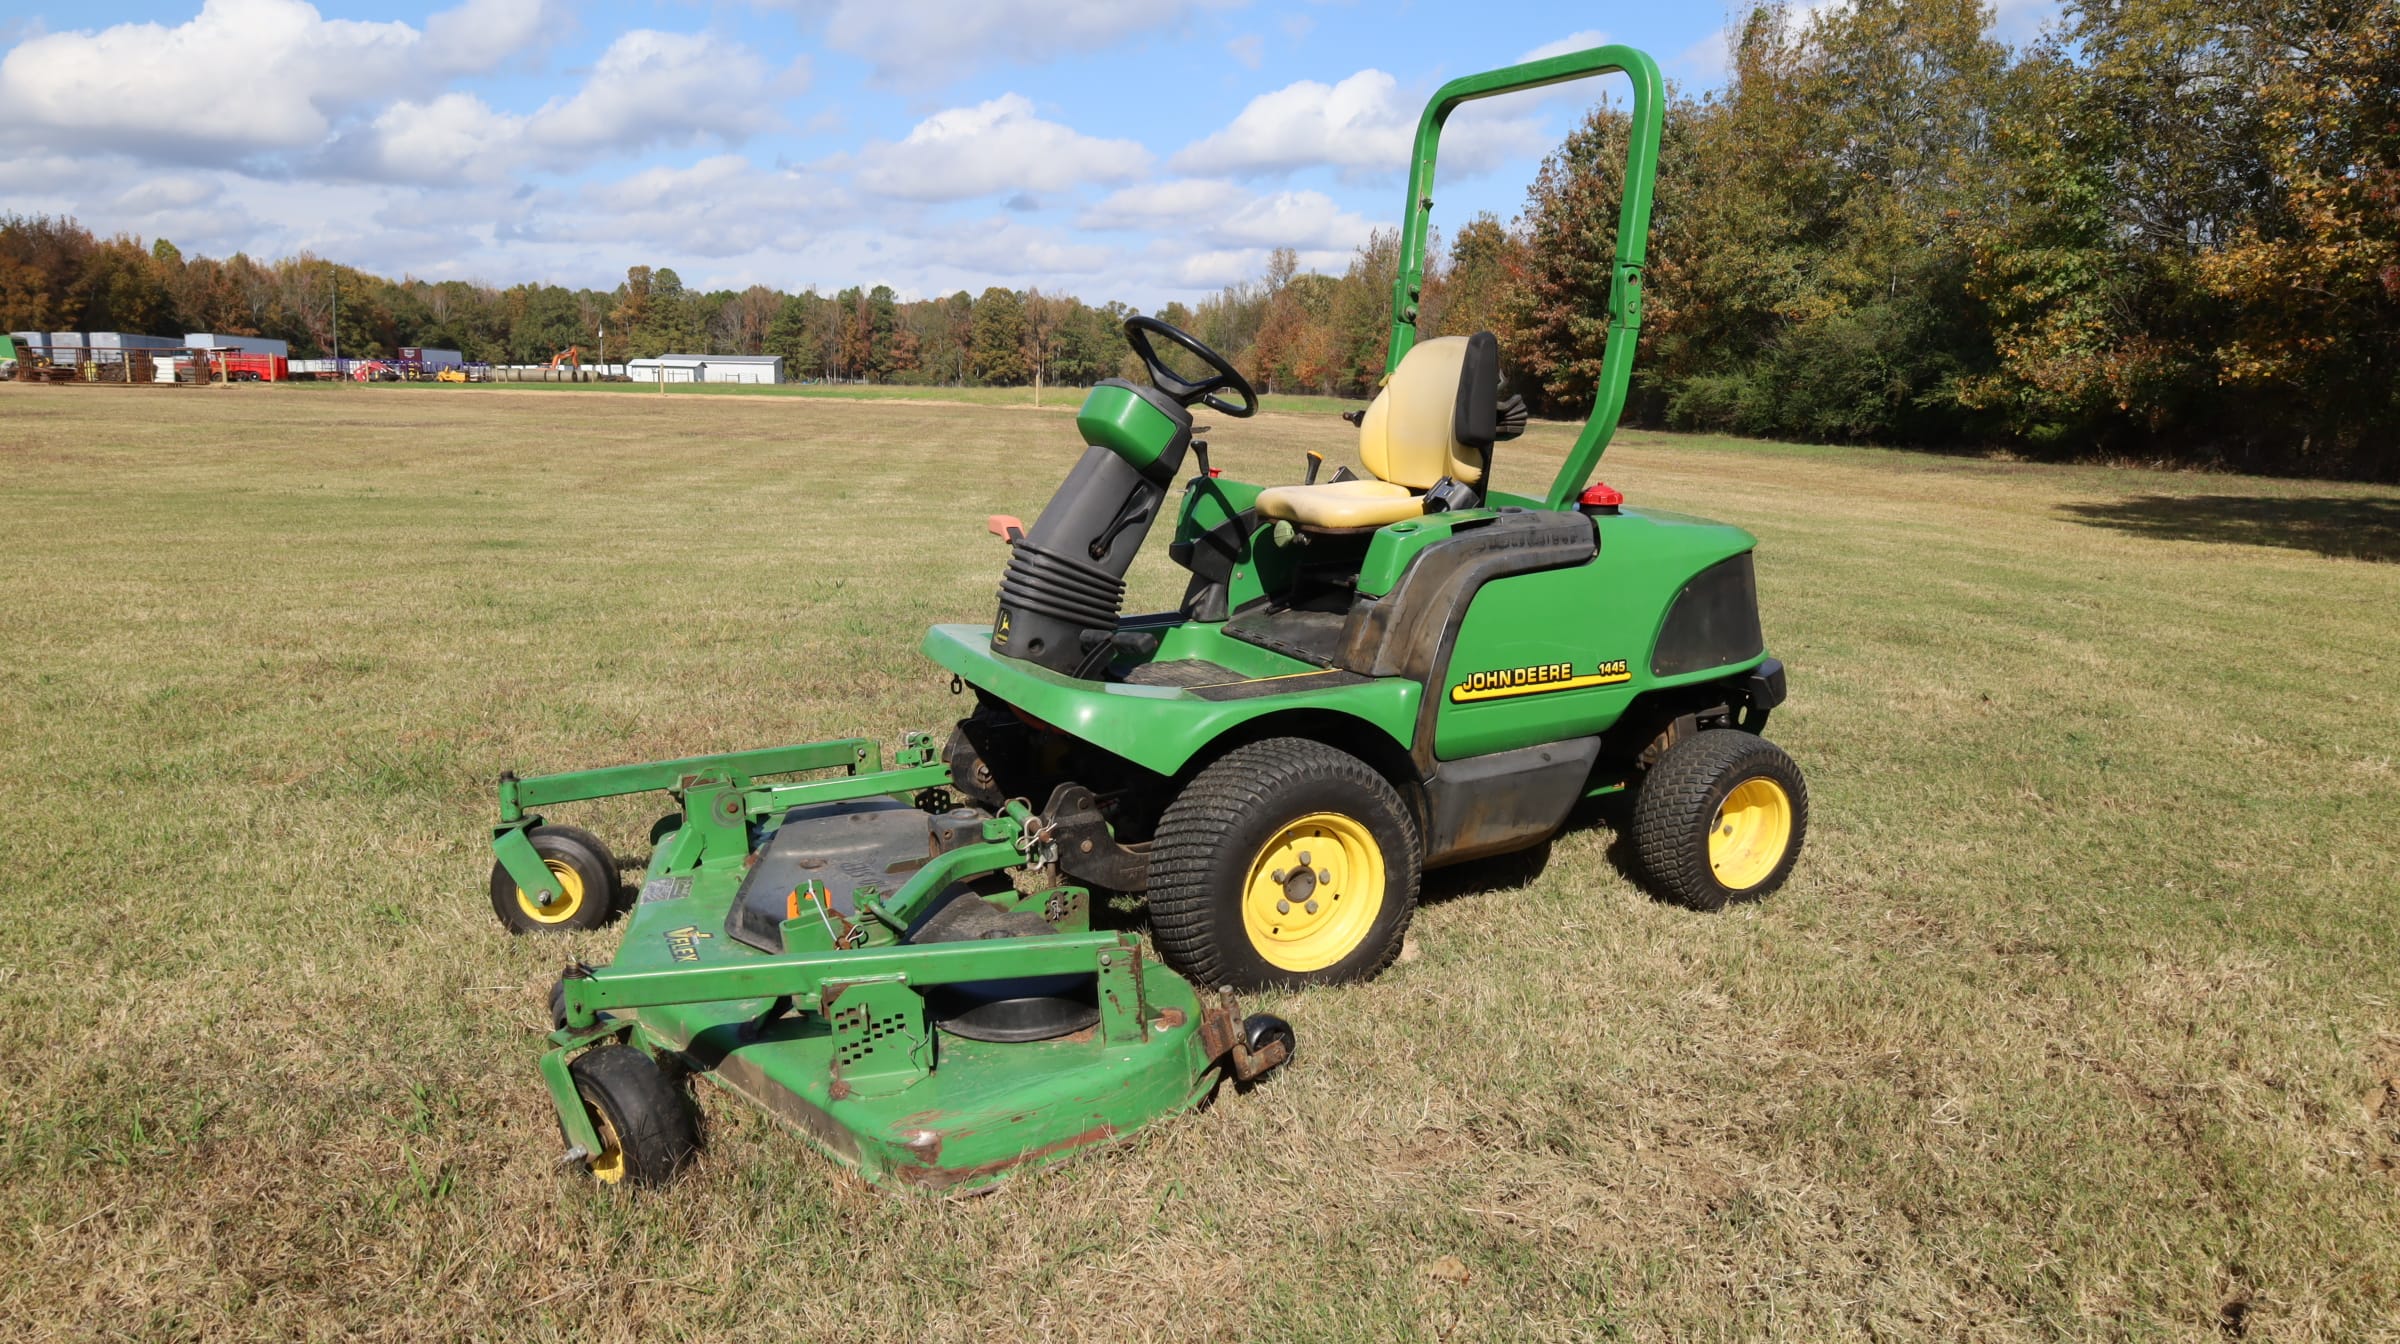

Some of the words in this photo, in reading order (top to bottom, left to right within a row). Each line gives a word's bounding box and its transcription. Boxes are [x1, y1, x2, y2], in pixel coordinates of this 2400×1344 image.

[1462, 670, 1511, 691] JOHN
[1514, 663, 1572, 684] DEERE
[1598, 660, 1626, 675] 1445
